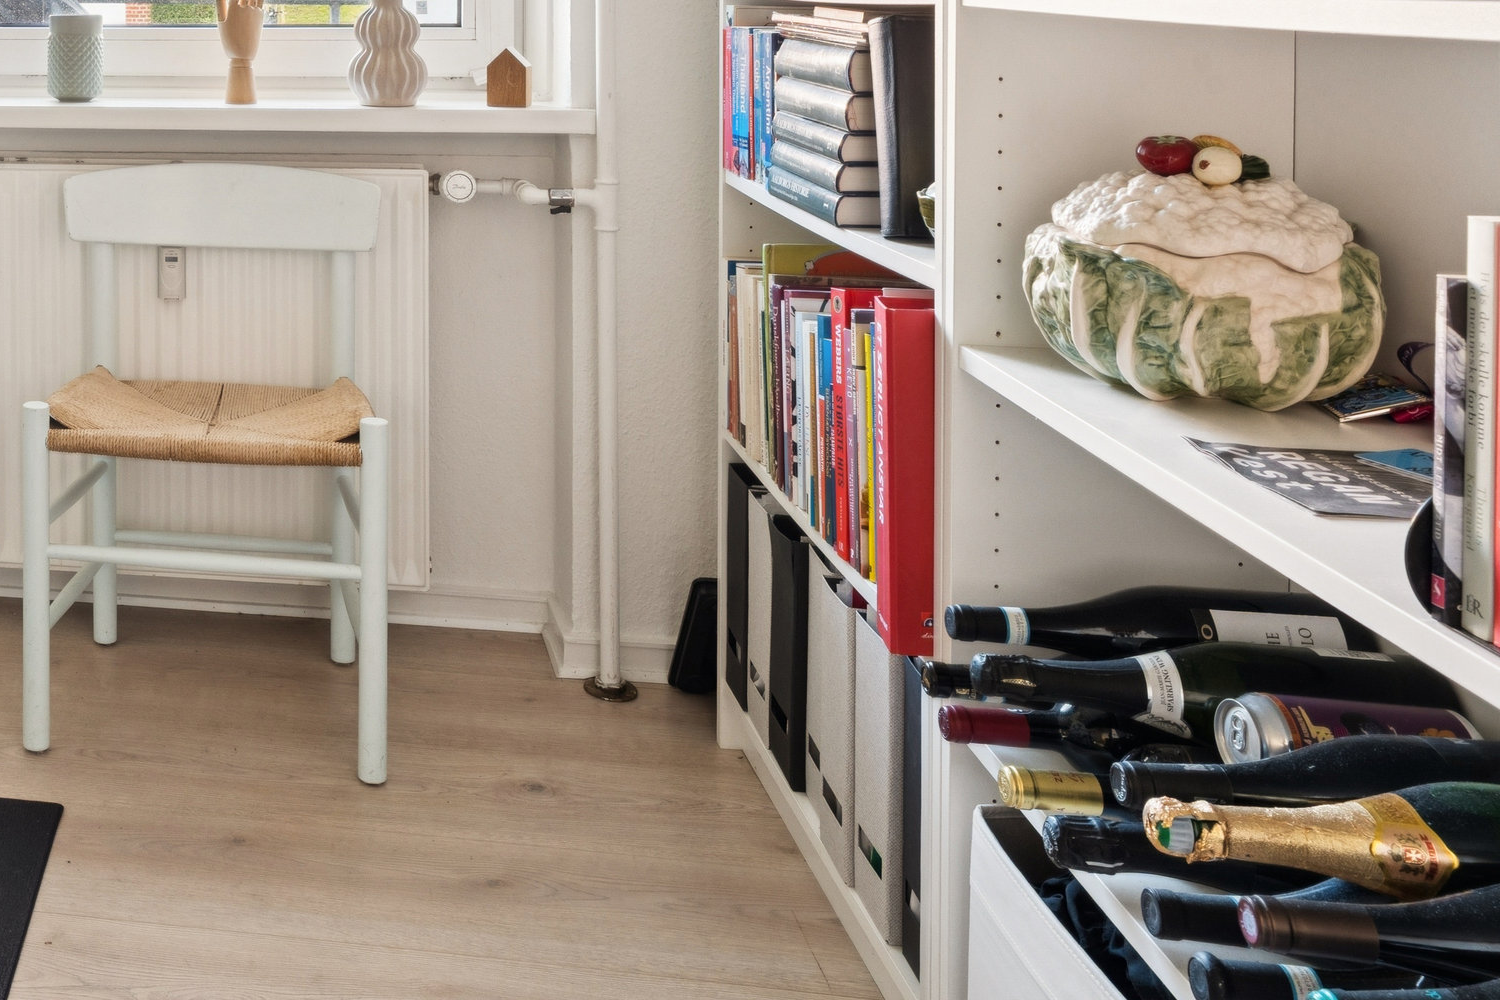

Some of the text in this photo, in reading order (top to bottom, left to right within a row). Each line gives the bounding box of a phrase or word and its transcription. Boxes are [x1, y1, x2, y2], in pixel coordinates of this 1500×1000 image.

[739, 56, 747, 114] Thailand
[764, 65, 772, 135] Argentina
[876, 321, 882, 346] ET
[1467, 287, 1477, 427] et menneske forbi
[1477, 271, 1490, 450] Hvis der skulle komme
[836, 395, 844, 457] STØRSTE
[837, 458, 845, 489] HITS
[1466, 473, 1475, 552] Korsgaard
[1475, 487, 1487, 548] Thomas
[1162, 668, 1175, 714] SPARKLING
